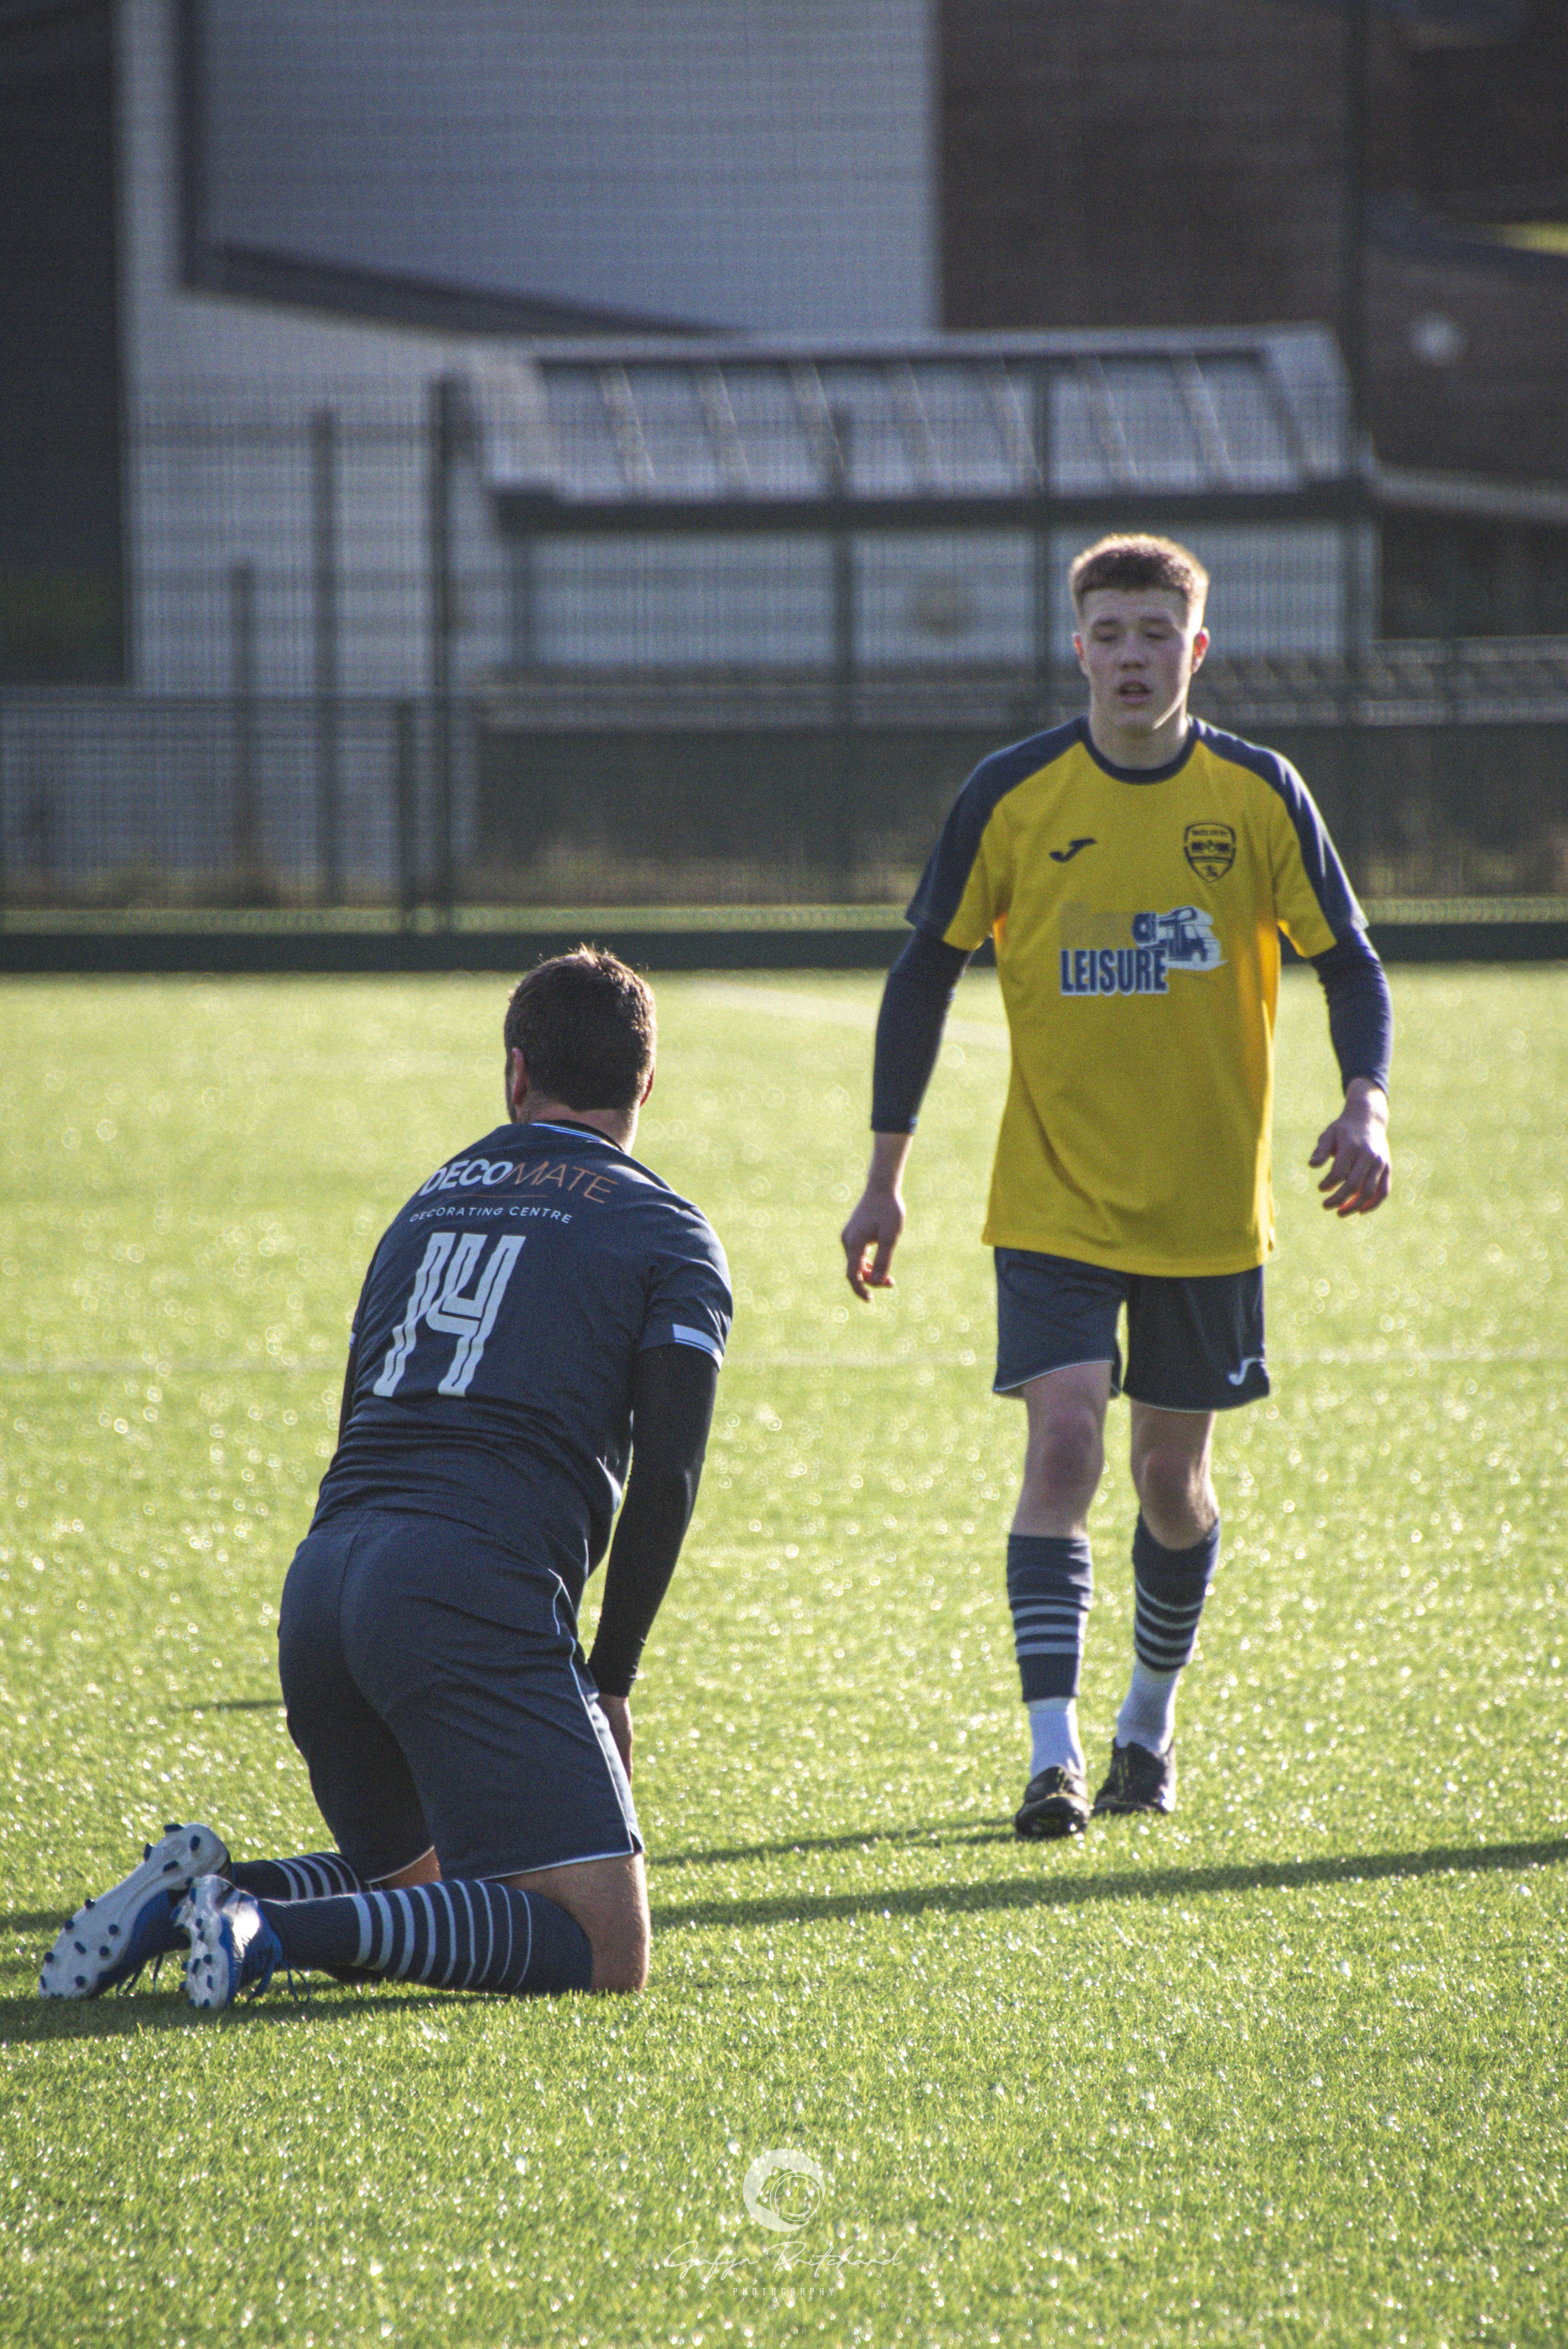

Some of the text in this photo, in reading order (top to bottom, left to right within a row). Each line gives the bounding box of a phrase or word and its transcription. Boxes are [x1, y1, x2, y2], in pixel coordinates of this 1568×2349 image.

[1060, 949, 1169, 996] LEISURE
[419, 1159, 619, 1204] DECOMATE
[409, 1206, 572, 1224] DECORATING CENTRE
[373, 1232, 526, 1397] 14
